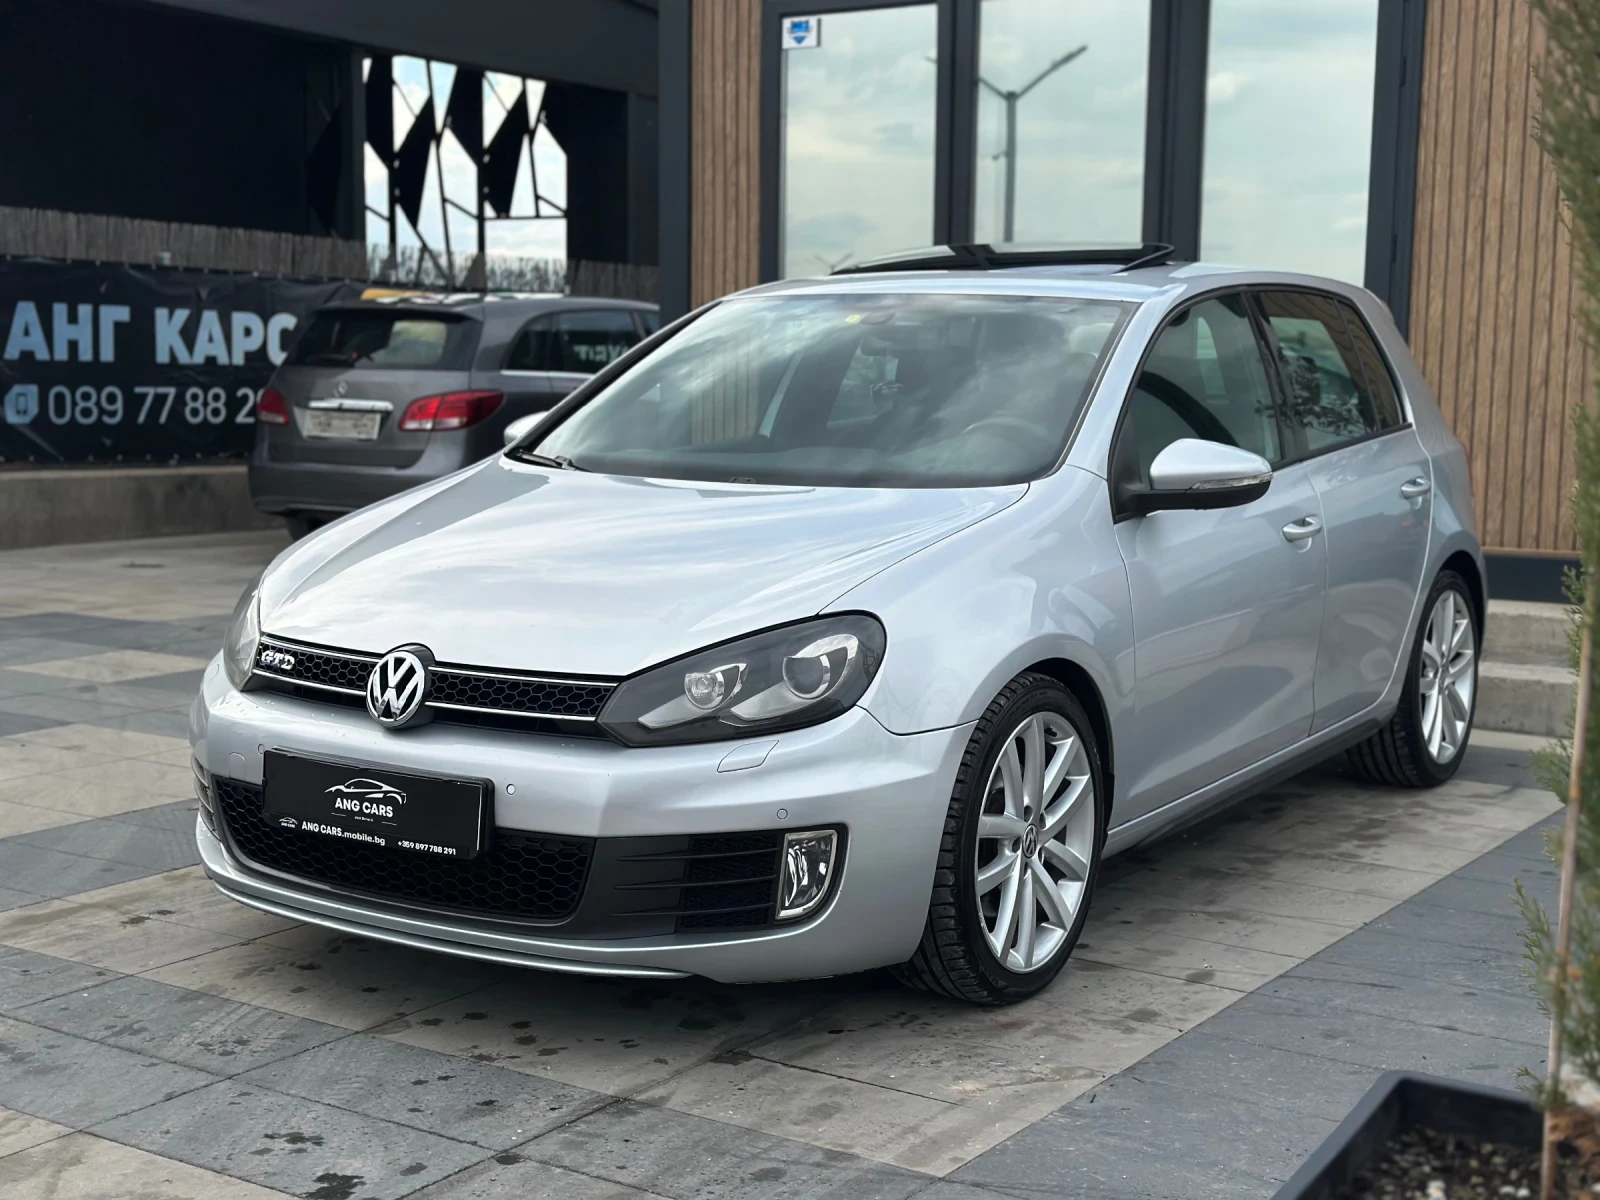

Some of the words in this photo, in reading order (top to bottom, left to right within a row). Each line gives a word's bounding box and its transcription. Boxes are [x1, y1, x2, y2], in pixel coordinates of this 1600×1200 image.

[3, 301, 131, 362] АНГ
[154, 307, 298, 366] КАРС
[48, 385, 124, 425] 089
[134, 386, 176, 424] 77
[185, 387, 227, 424] 88
[235, 387, 265, 424] 2
[261, 650, 295, 670] GTD
[335, 797, 361, 812] ANG
[362, 801, 393, 818] CARS
[301, 820, 319, 832] ANG
[320, 824, 386, 846] CARS.mobile.bg
[397, 840, 415, 849] +359
[415, 842, 428, 851] 897
[429, 845, 443, 854] 788
[443, 847, 456, 855] 291
